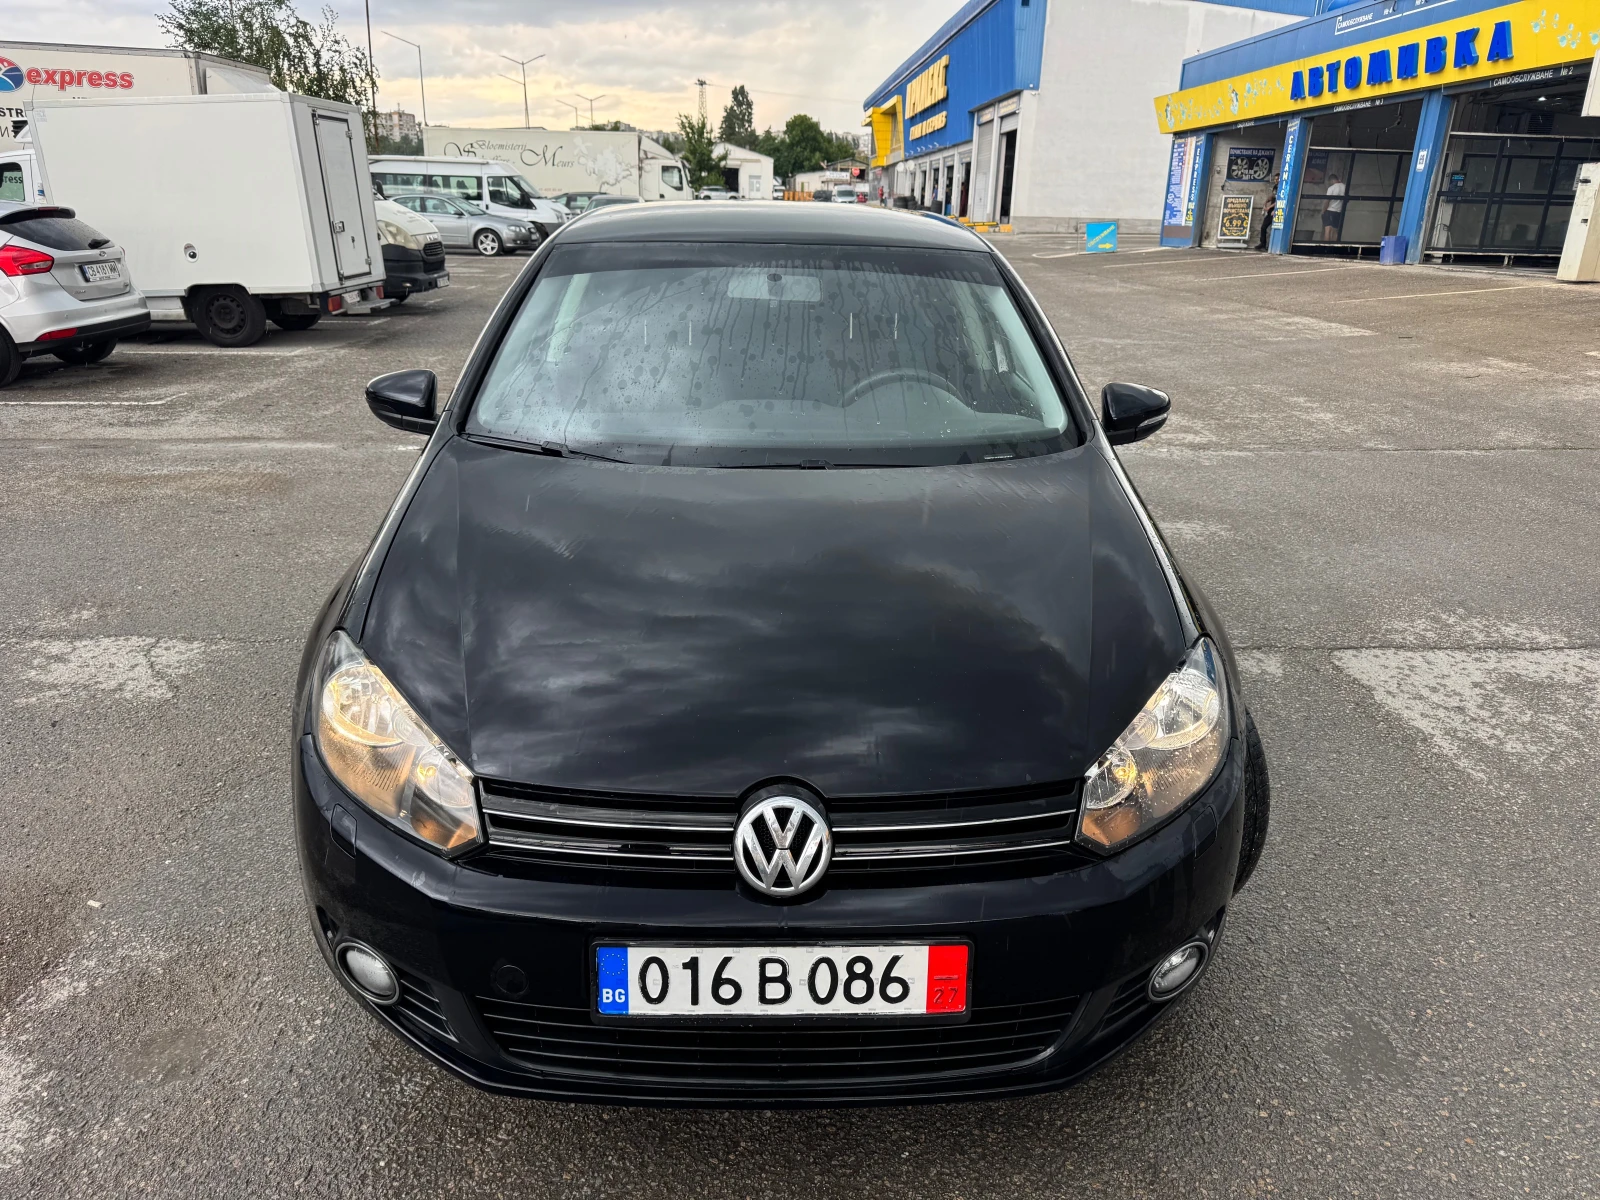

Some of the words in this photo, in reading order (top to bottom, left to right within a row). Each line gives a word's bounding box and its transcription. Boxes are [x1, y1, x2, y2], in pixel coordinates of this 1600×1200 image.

[1290, 20, 1514, 101] АВТОМИВКА
[25, 67, 134, 91] express
[1493, 69, 1554, 87] САМООБСЛУЖВАНЕ
[0, 107, 27, 118] STR
[520, 144, 575, 168] Meurs
[1280, 135, 1295, 199] CERAMIC
[638, 955, 742, 1006] 016
[758, 955, 792, 1006] B
[807, 954, 911, 1006] 086
[602, 988, 626, 1004] BG
[933, 986, 958, 1004] 27
